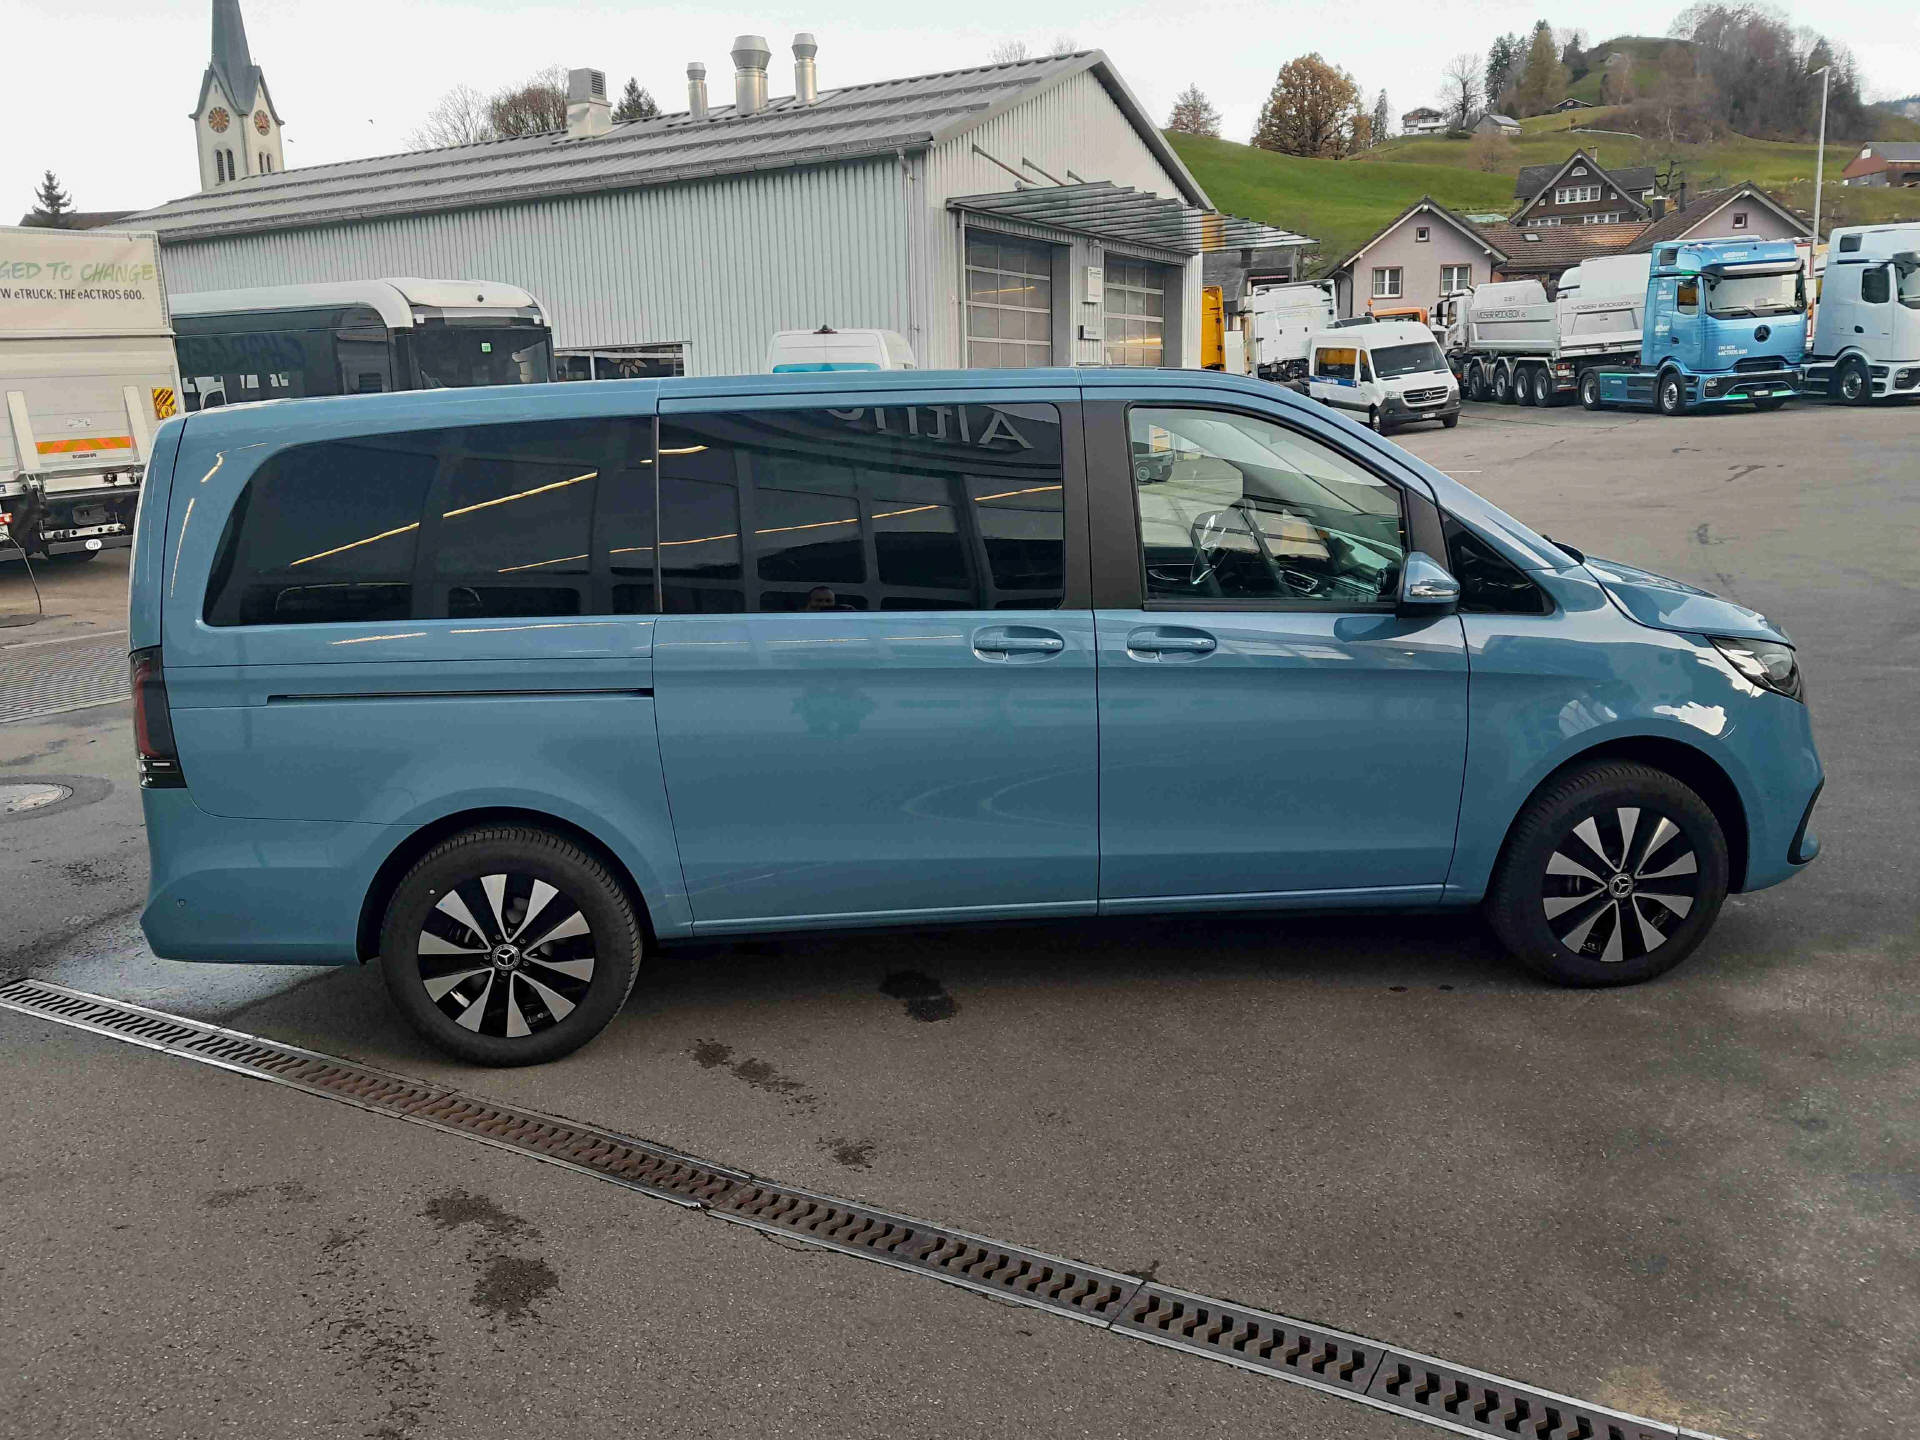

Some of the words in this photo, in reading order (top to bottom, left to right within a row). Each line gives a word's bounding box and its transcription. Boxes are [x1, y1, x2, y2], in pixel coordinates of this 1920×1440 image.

[46, 261, 73, 281] TO
[80, 262, 154, 285] CHANGE
[14, 288, 57, 300] eTRUCK:
[60, 289, 76, 300] THE
[78, 289, 122, 300] eACTROS
[124, 289, 145, 300] 600.
